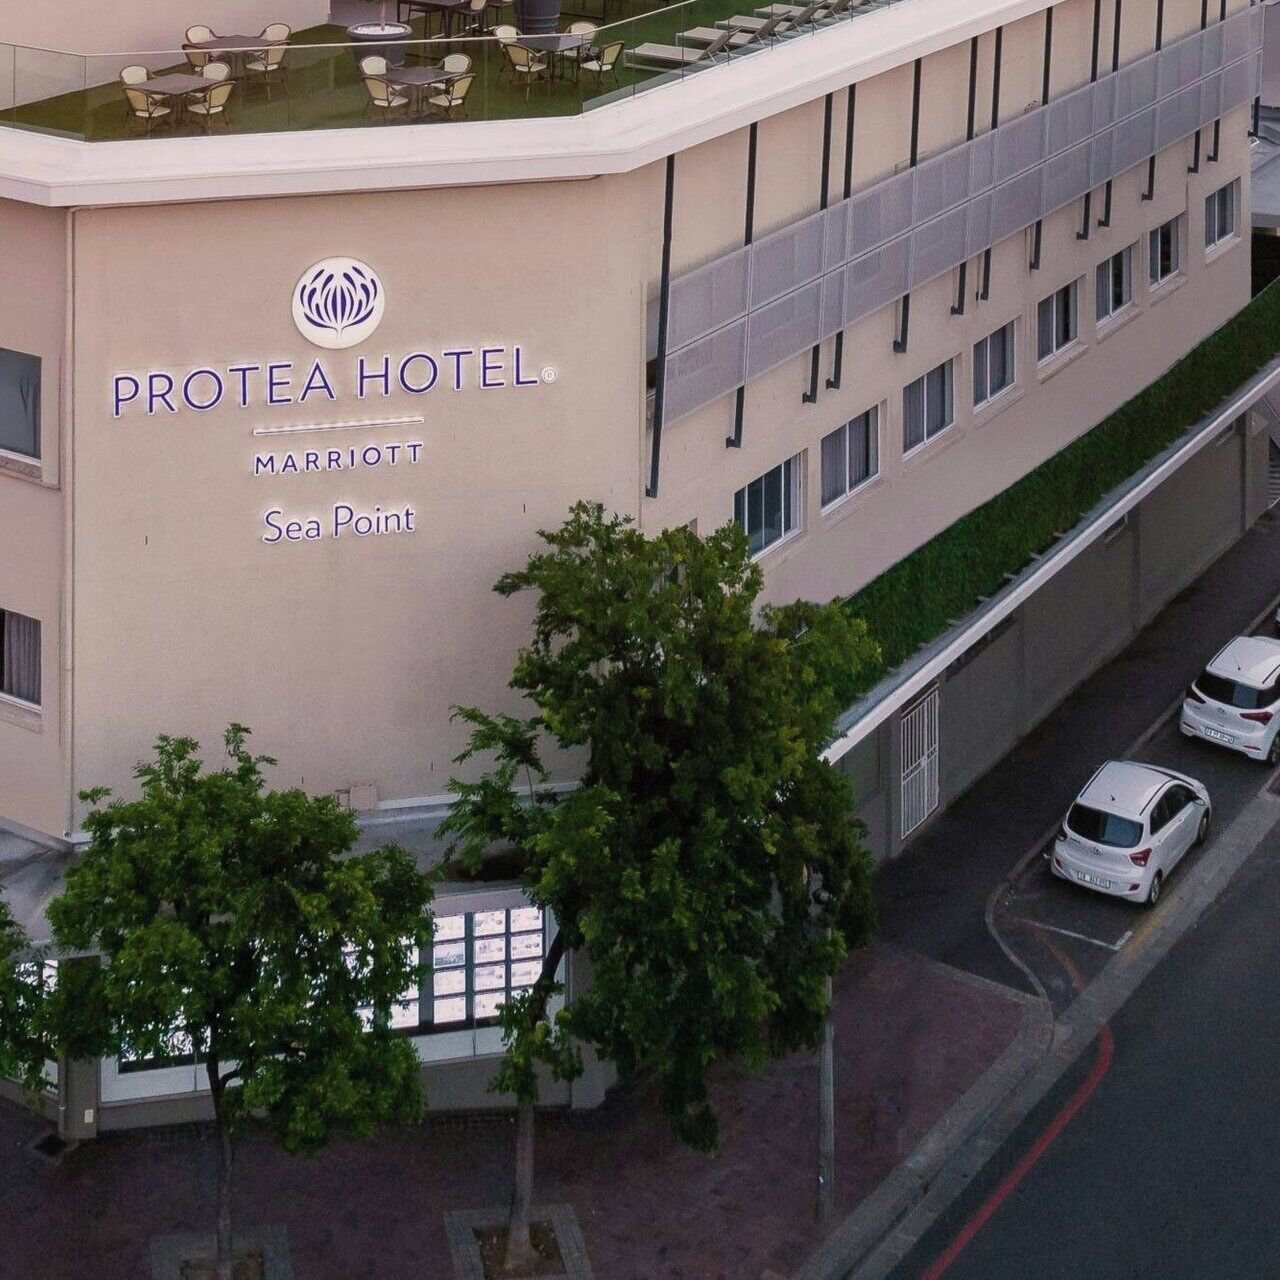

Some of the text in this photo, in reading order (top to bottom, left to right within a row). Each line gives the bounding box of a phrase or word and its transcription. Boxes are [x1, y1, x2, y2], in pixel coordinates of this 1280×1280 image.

[112, 345, 539, 418] PROTEA HOTEL
[254, 442, 424, 475] MARRIOTT
[263, 504, 415, 543] Sea Point
